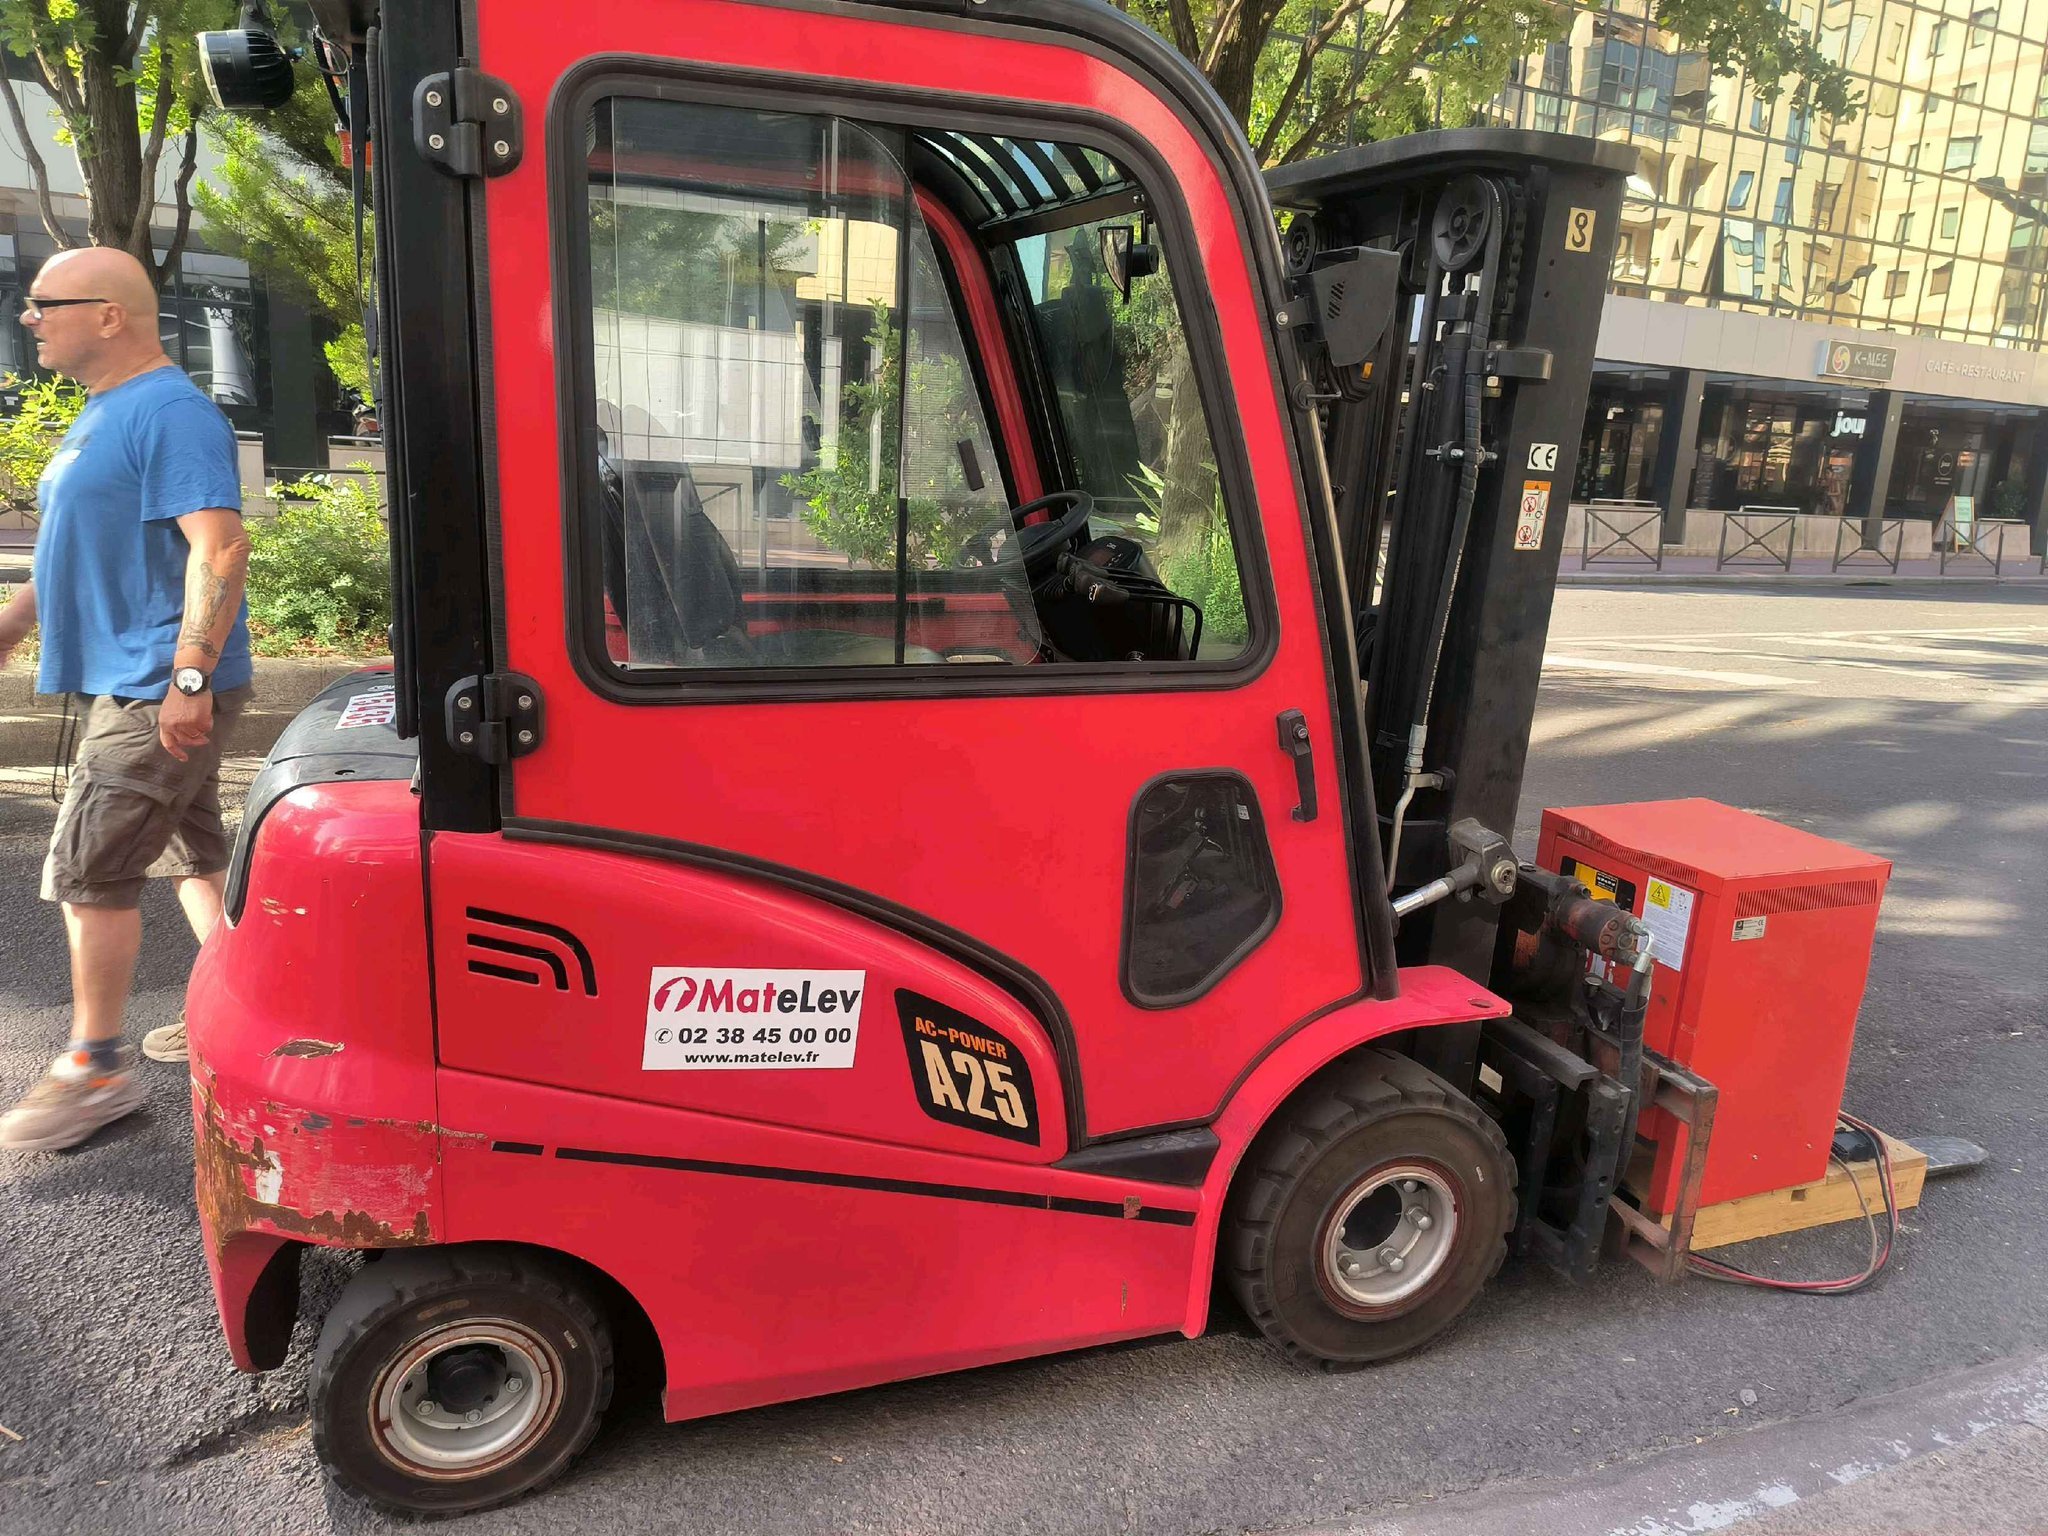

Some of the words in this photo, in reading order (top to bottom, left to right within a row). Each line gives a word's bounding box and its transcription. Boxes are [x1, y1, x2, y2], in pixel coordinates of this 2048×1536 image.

[1961, 363, 2026, 382] RESTAURANT
[1830, 411, 1866, 438] jou
[1531, 445, 1556, 468] CE
[697, 979, 860, 1013] MateLev
[678, 1028, 708, 1044] 02
[716, 1028, 745, 1044] 38
[752, 1028, 782, 1044] 45
[789, 1028, 817, 1044] 00
[824, 1028, 852, 1044] 00
[915, 1016, 1008, 1060] AC-POWER
[684, 1051, 820, 1063] www.matelev.fr
[920, 1039, 1029, 1129] A25
